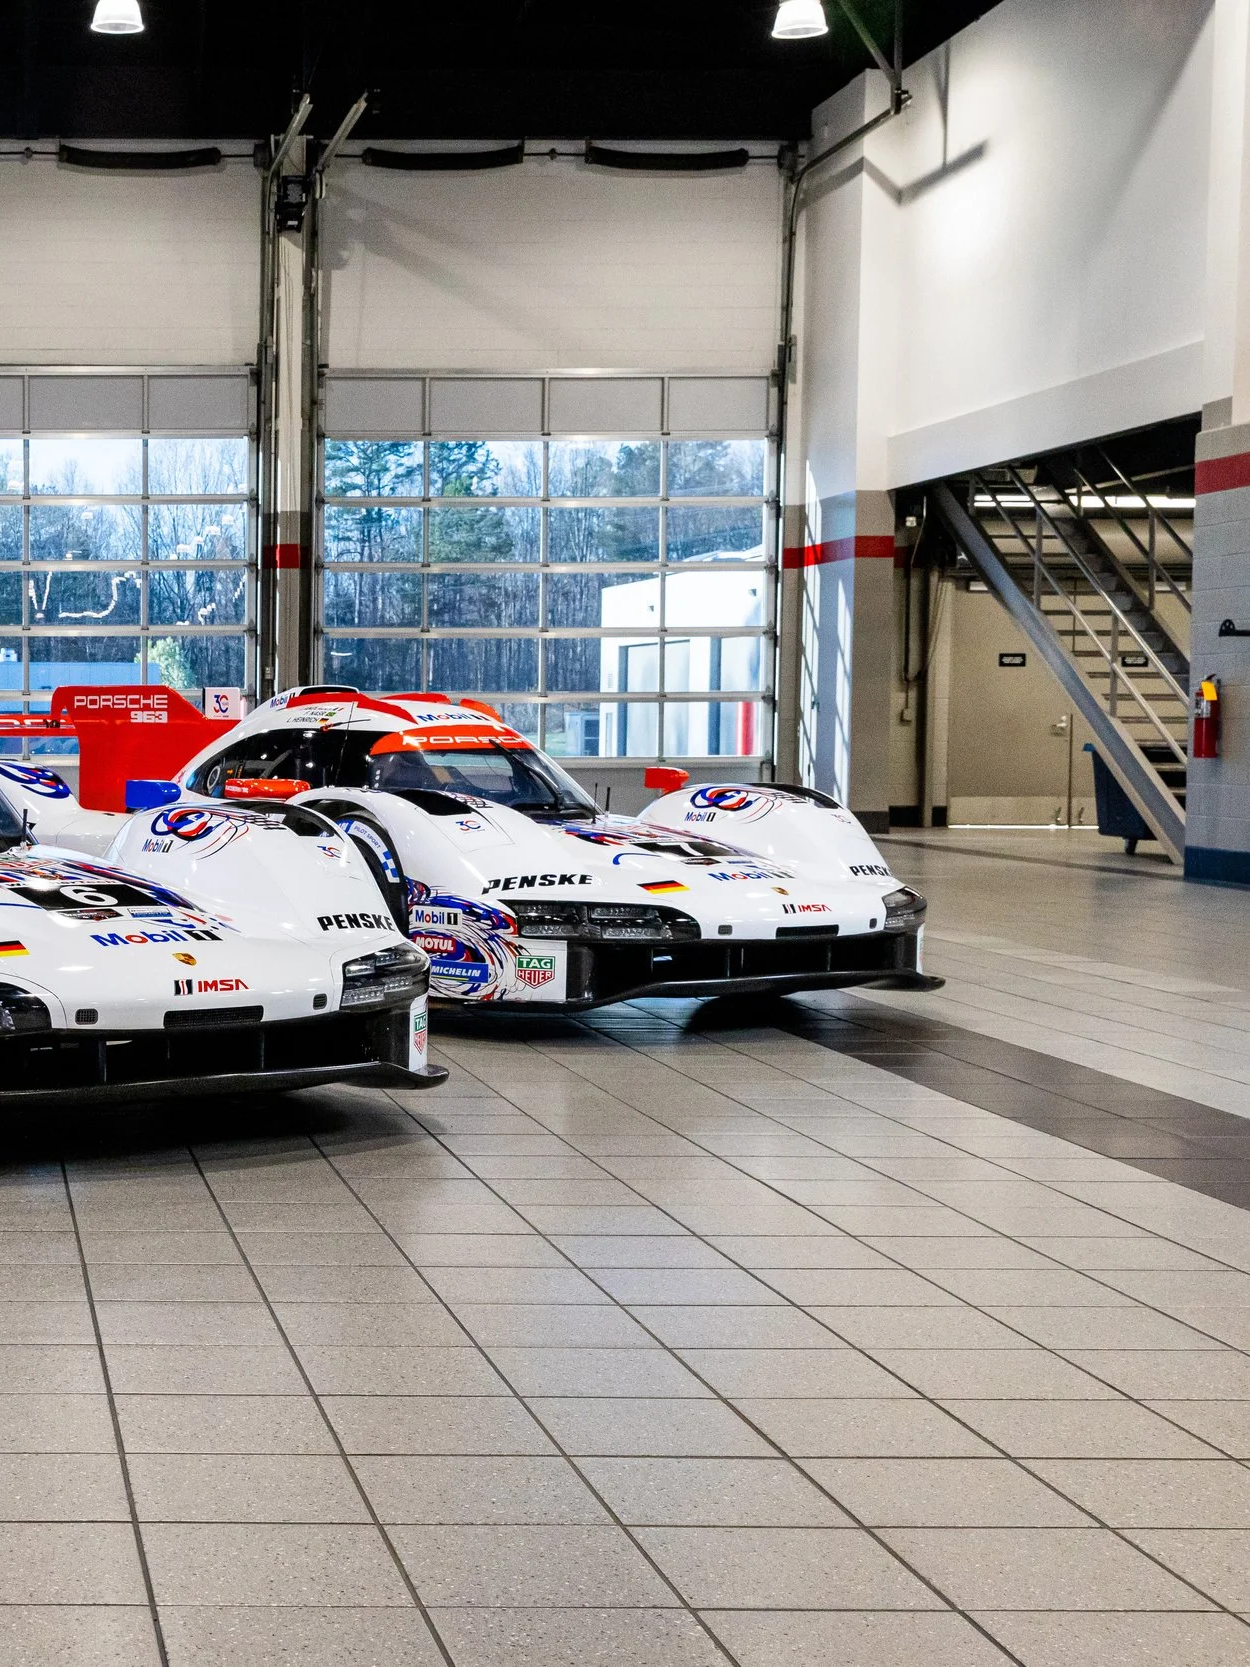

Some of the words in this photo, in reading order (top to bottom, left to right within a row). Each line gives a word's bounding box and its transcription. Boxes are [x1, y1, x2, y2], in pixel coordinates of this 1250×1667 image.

[74, 694, 168, 709] PORSCHE
[130, 711, 168, 723] 963
[417, 712, 471, 722] Mobil
[684, 812, 707, 822] Mobil
[354, 824, 367, 835] PILOT
[365, 832, 381, 849] SPORT
[142, 838, 164, 852] Mobil
[707, 869, 772, 882] Mobil
[849, 865, 892, 877] PENSK
[481, 873, 593, 894] PENSKE
[59, 885, 119, 906] 6
[797, 904, 831, 912] IMSA
[317, 913, 395, 931] PENSKE
[415, 909, 444, 924] Mobil
[447, 912, 458, 925] 1
[89, 930, 188, 947] Mobil
[182, 930, 224, 941] 1
[414, 937, 455, 951] MOTUL
[519, 958, 551, 969] TAG
[431, 965, 481, 977] MICHELIN
[197, 978, 250, 993] IMSA
[518, 971, 552, 987] HEUER
